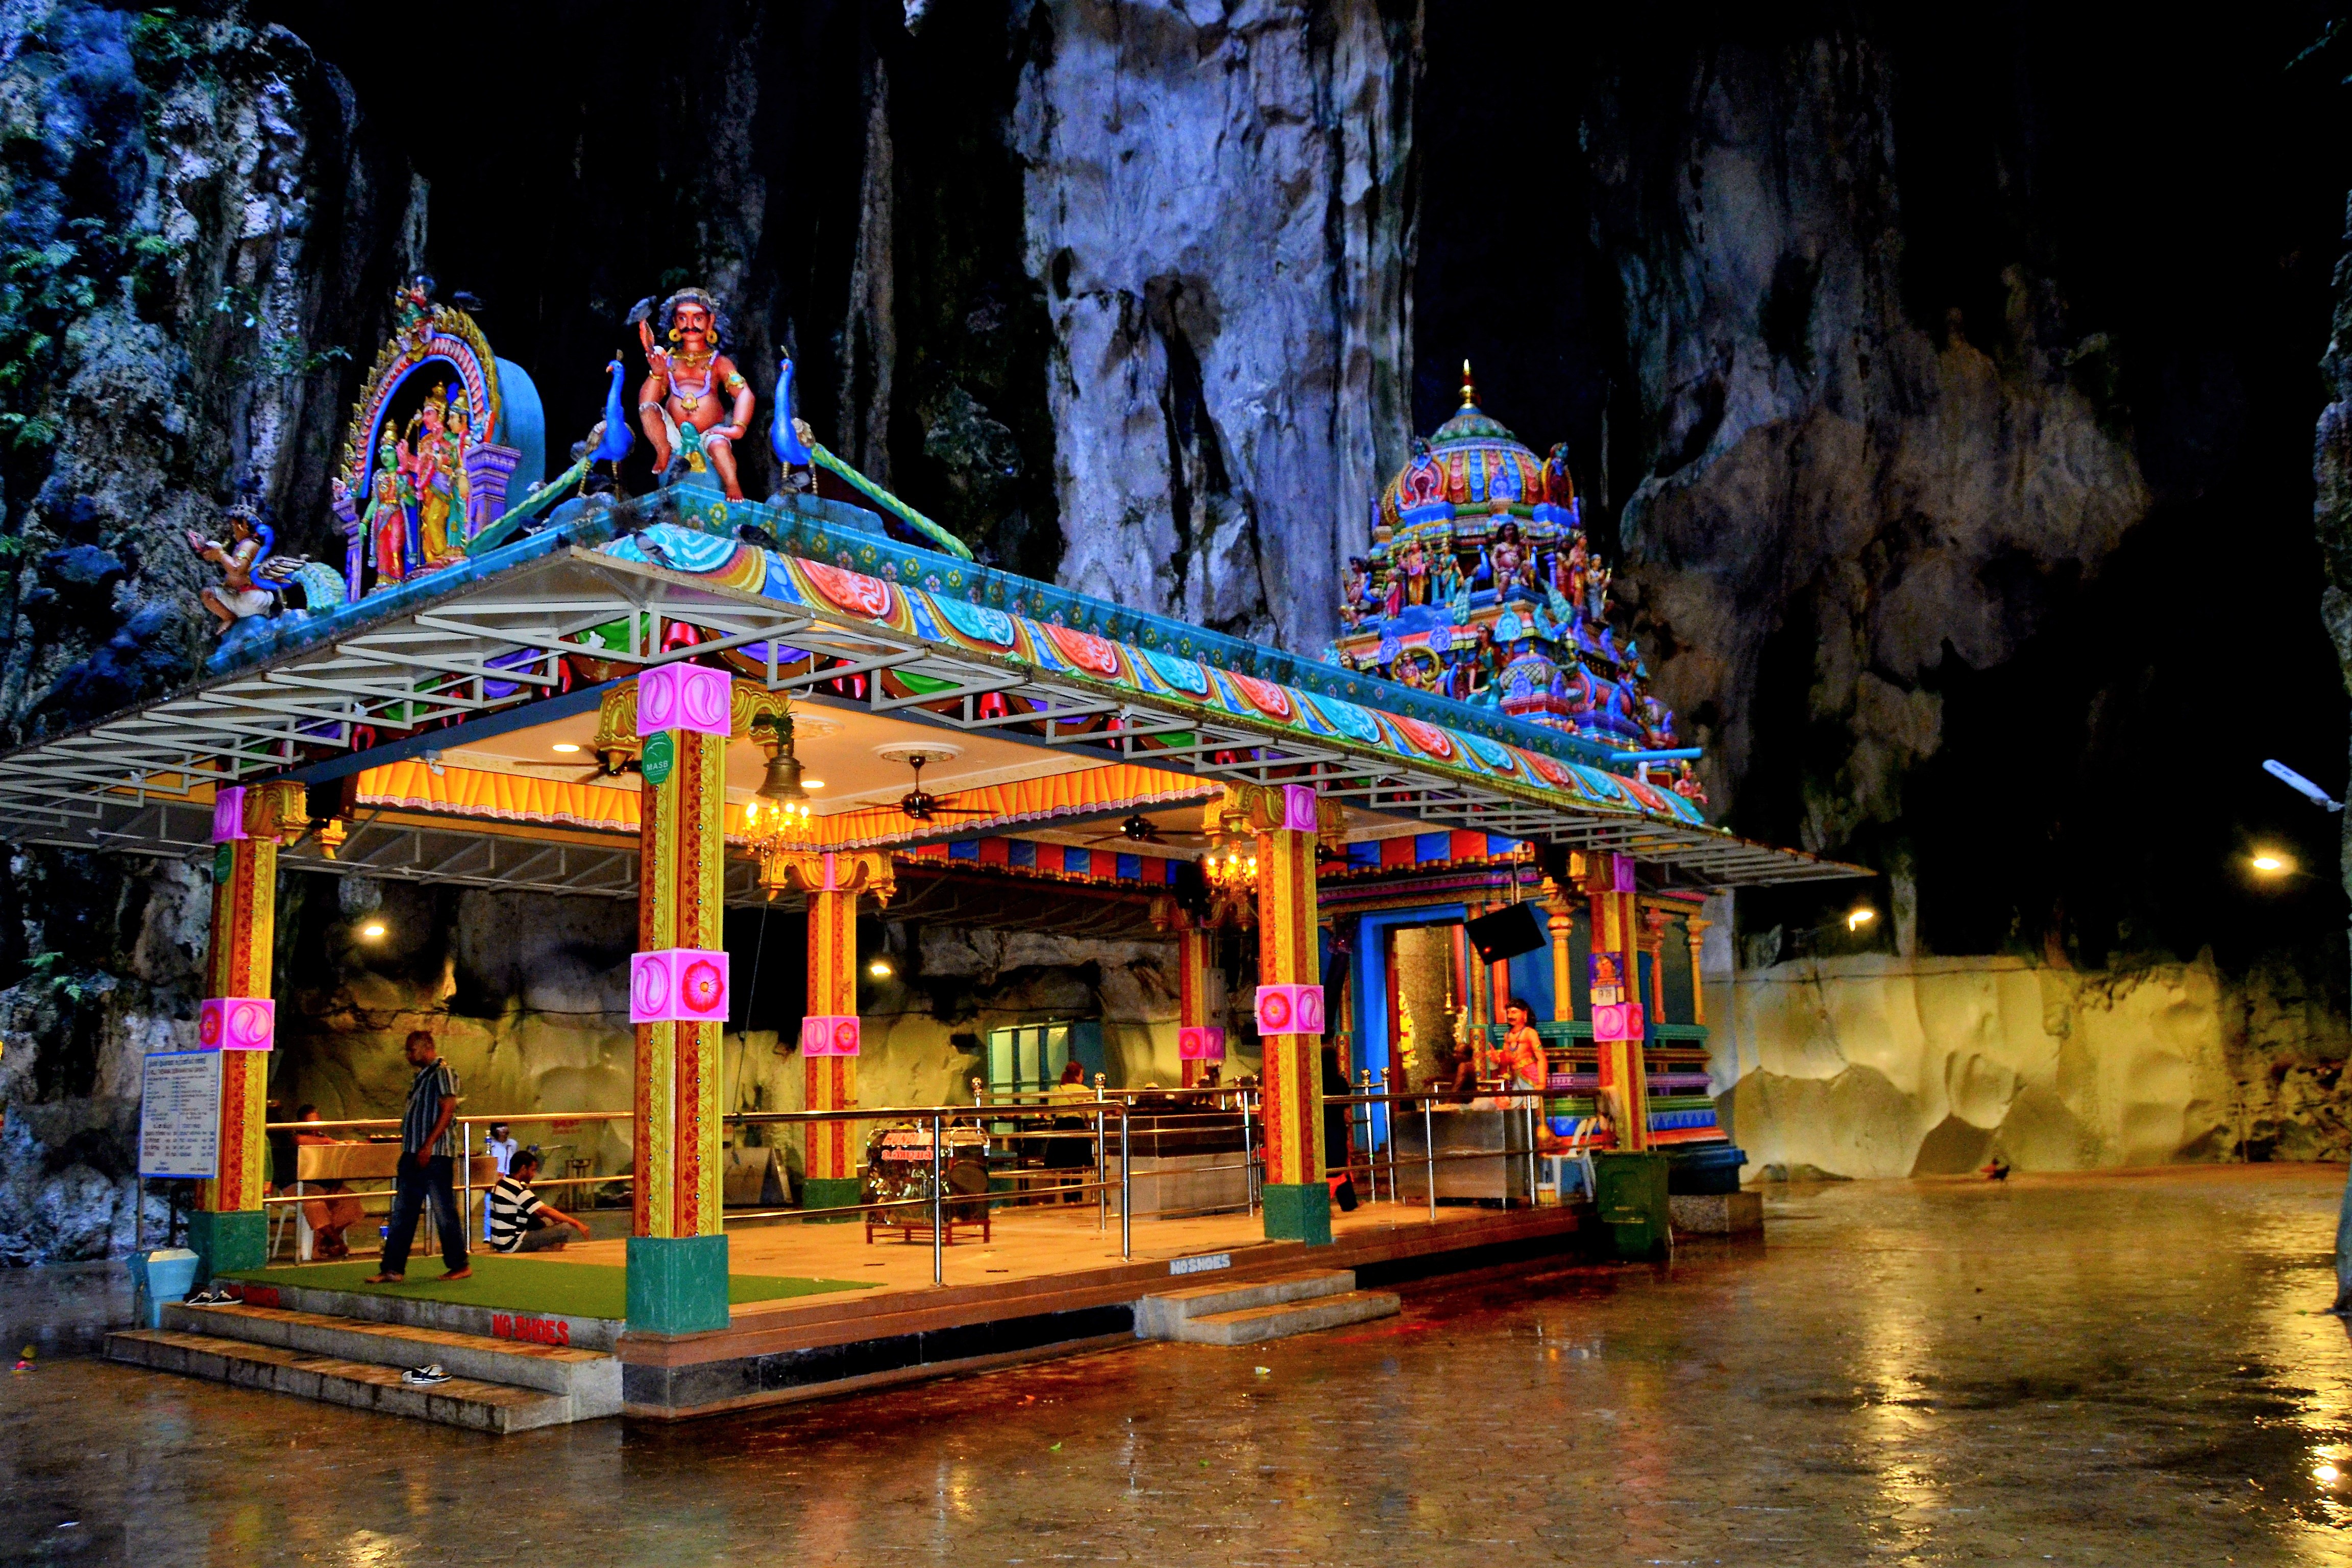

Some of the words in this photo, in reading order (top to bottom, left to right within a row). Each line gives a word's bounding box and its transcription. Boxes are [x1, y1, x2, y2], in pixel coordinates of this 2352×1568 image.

[646, 761, 668, 771] MASB
[1170, 1260, 1188, 1275] NO
[1189, 1254, 1230, 1272] SHOES
[493, 1314, 512, 1338] NO
[514, 1315, 569, 1345] SHOES
